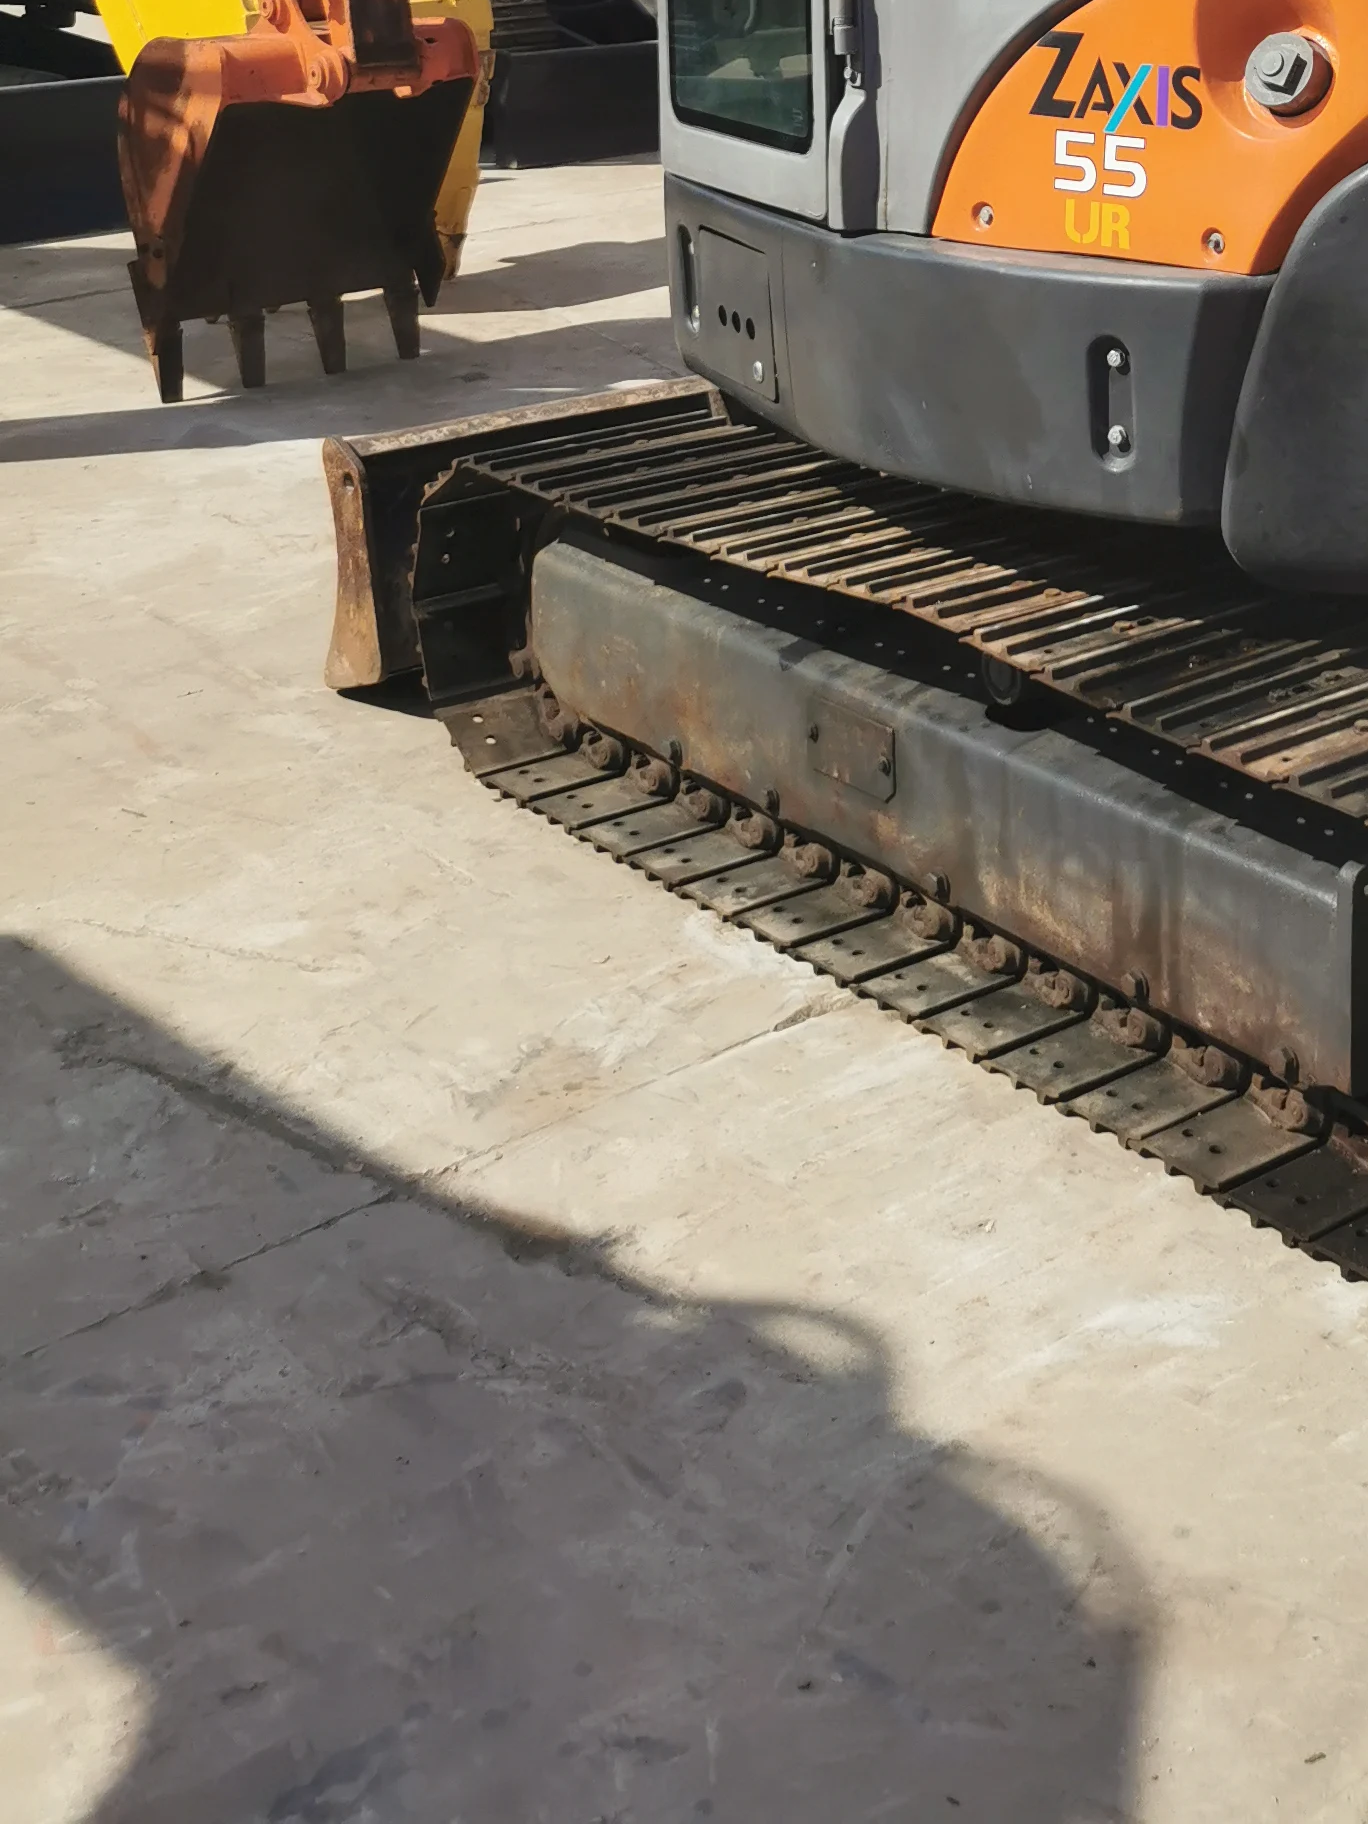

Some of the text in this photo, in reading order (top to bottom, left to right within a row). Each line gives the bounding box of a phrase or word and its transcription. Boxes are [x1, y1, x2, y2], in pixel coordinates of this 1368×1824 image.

[1029, 31, 1203, 133] ZAXIS
[1053, 129, 1148, 199] 55
[1064, 198, 1131, 250] UR
